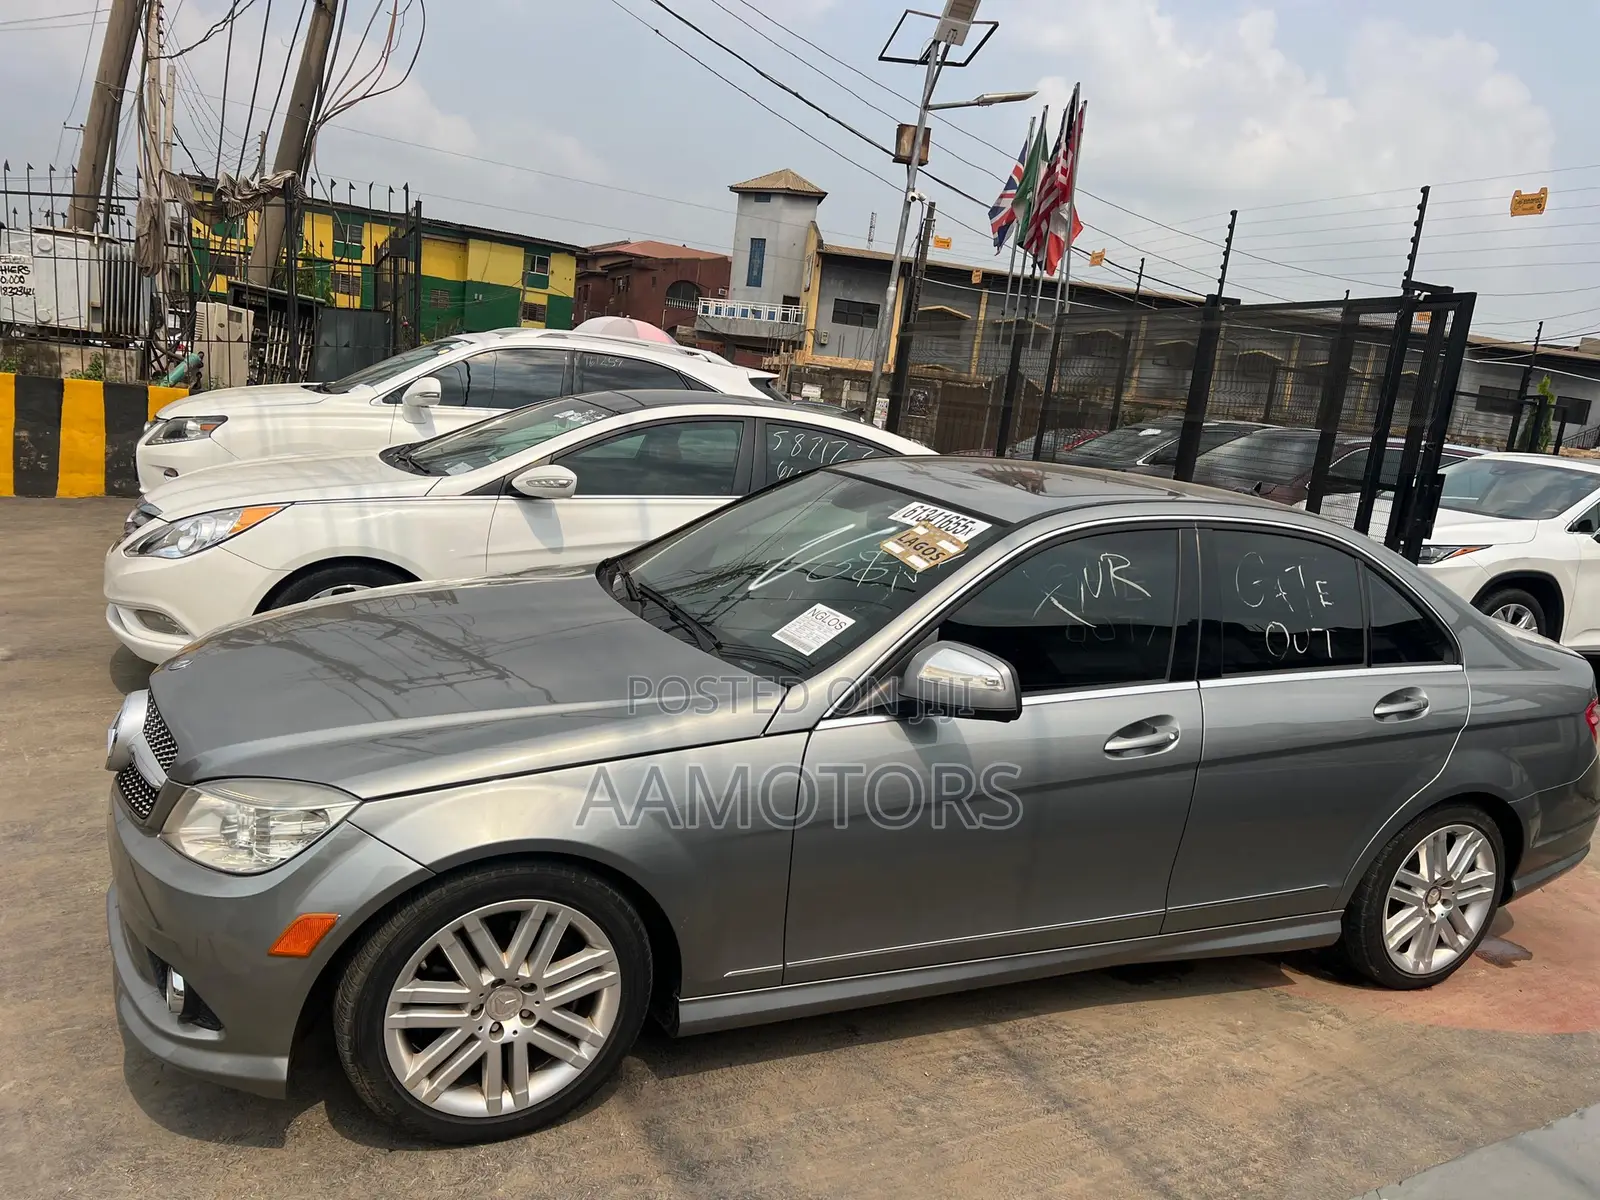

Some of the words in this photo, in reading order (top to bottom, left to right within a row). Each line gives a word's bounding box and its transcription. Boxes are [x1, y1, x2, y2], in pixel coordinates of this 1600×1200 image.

[897, 532, 947, 562] LAGOS
[807, 607, 847, 631] NGLOS
[1265, 621, 1334, 661] OUT
